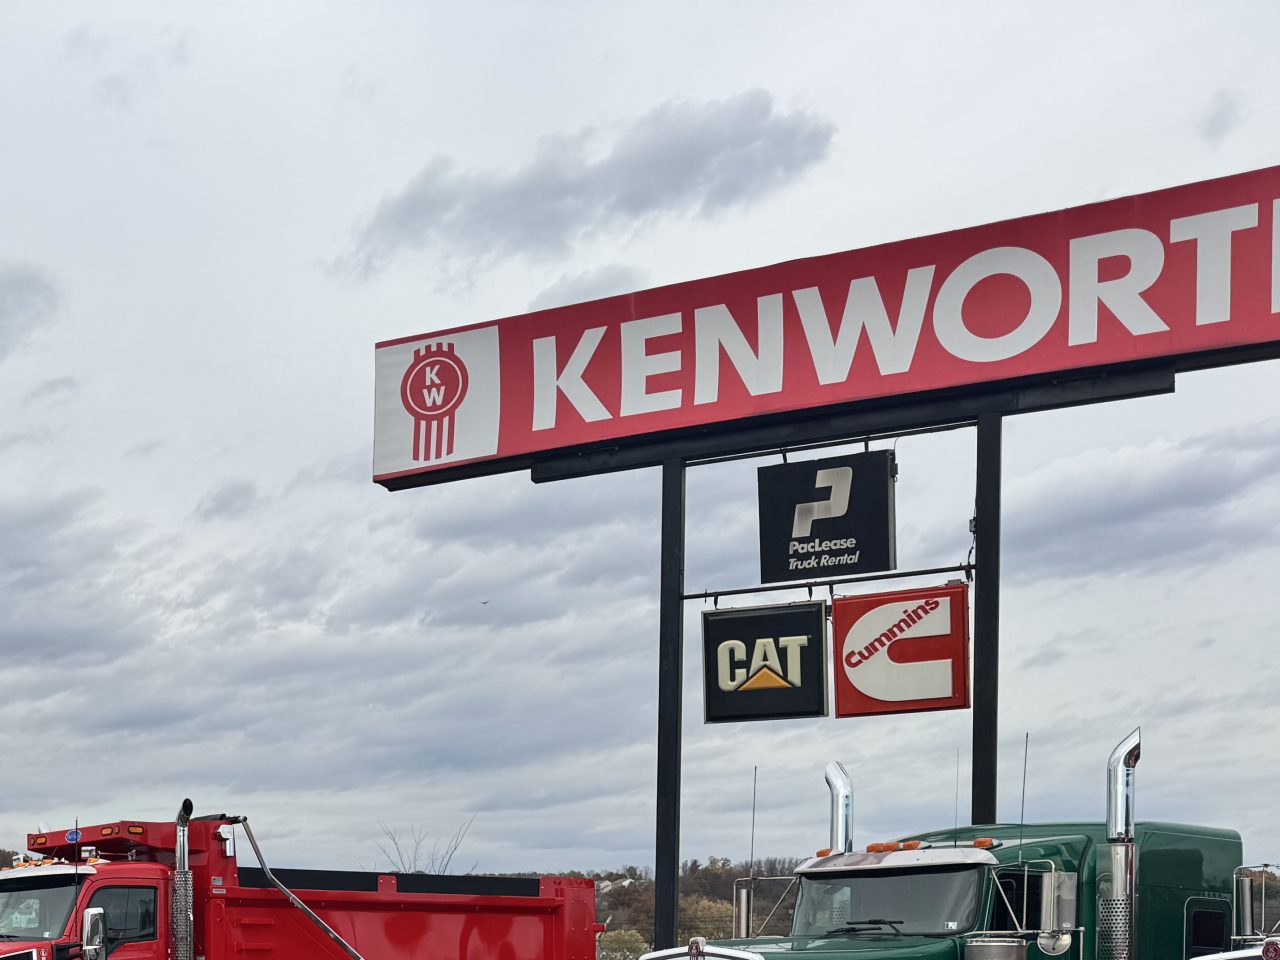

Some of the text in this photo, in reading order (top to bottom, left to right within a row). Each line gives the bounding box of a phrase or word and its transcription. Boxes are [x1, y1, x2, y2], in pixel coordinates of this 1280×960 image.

[531, 197, 1280, 432] KENWORT
[425, 364, 442, 386] K
[422, 385, 446, 408] W
[788, 537, 857, 555] PacLease
[788, 550, 860, 570] Truck Rental
[844, 598, 940, 669] Cummins
[716, 635, 809, 692] CAT
